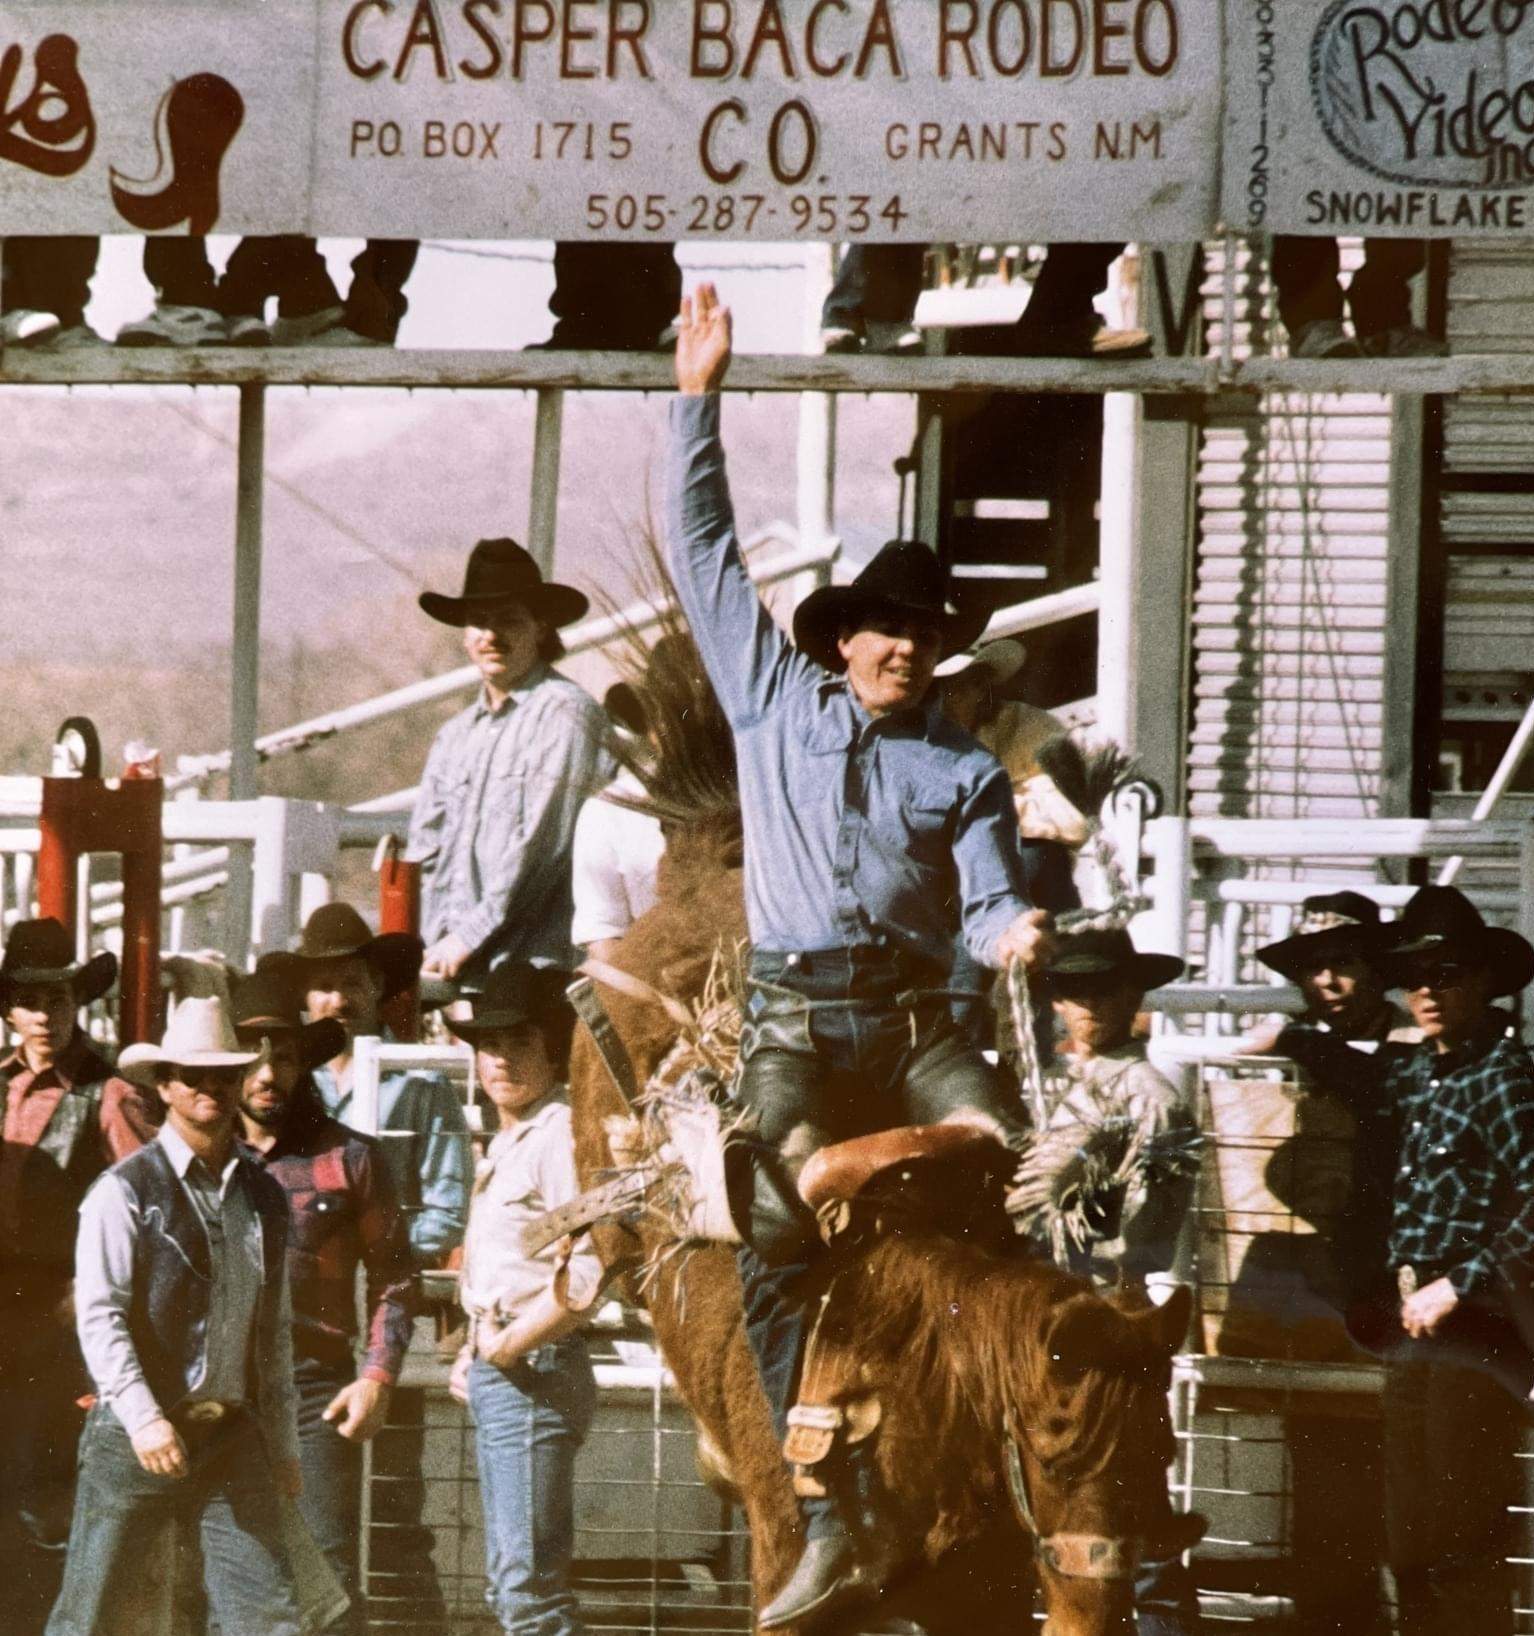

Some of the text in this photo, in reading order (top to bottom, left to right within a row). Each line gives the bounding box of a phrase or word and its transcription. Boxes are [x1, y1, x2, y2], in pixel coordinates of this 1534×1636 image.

[342, 0, 1180, 80] CASPER BACA RODEO
[424, 121, 502, 159] BOX
[533, 122, 632, 160] 1715
[699, 98, 828, 186] CO.
[885, 121, 1067, 160] GRANTS
[586, 195, 908, 233] 505-287-9534
[1306, 189, 1526, 228] SNOWFLAKE
